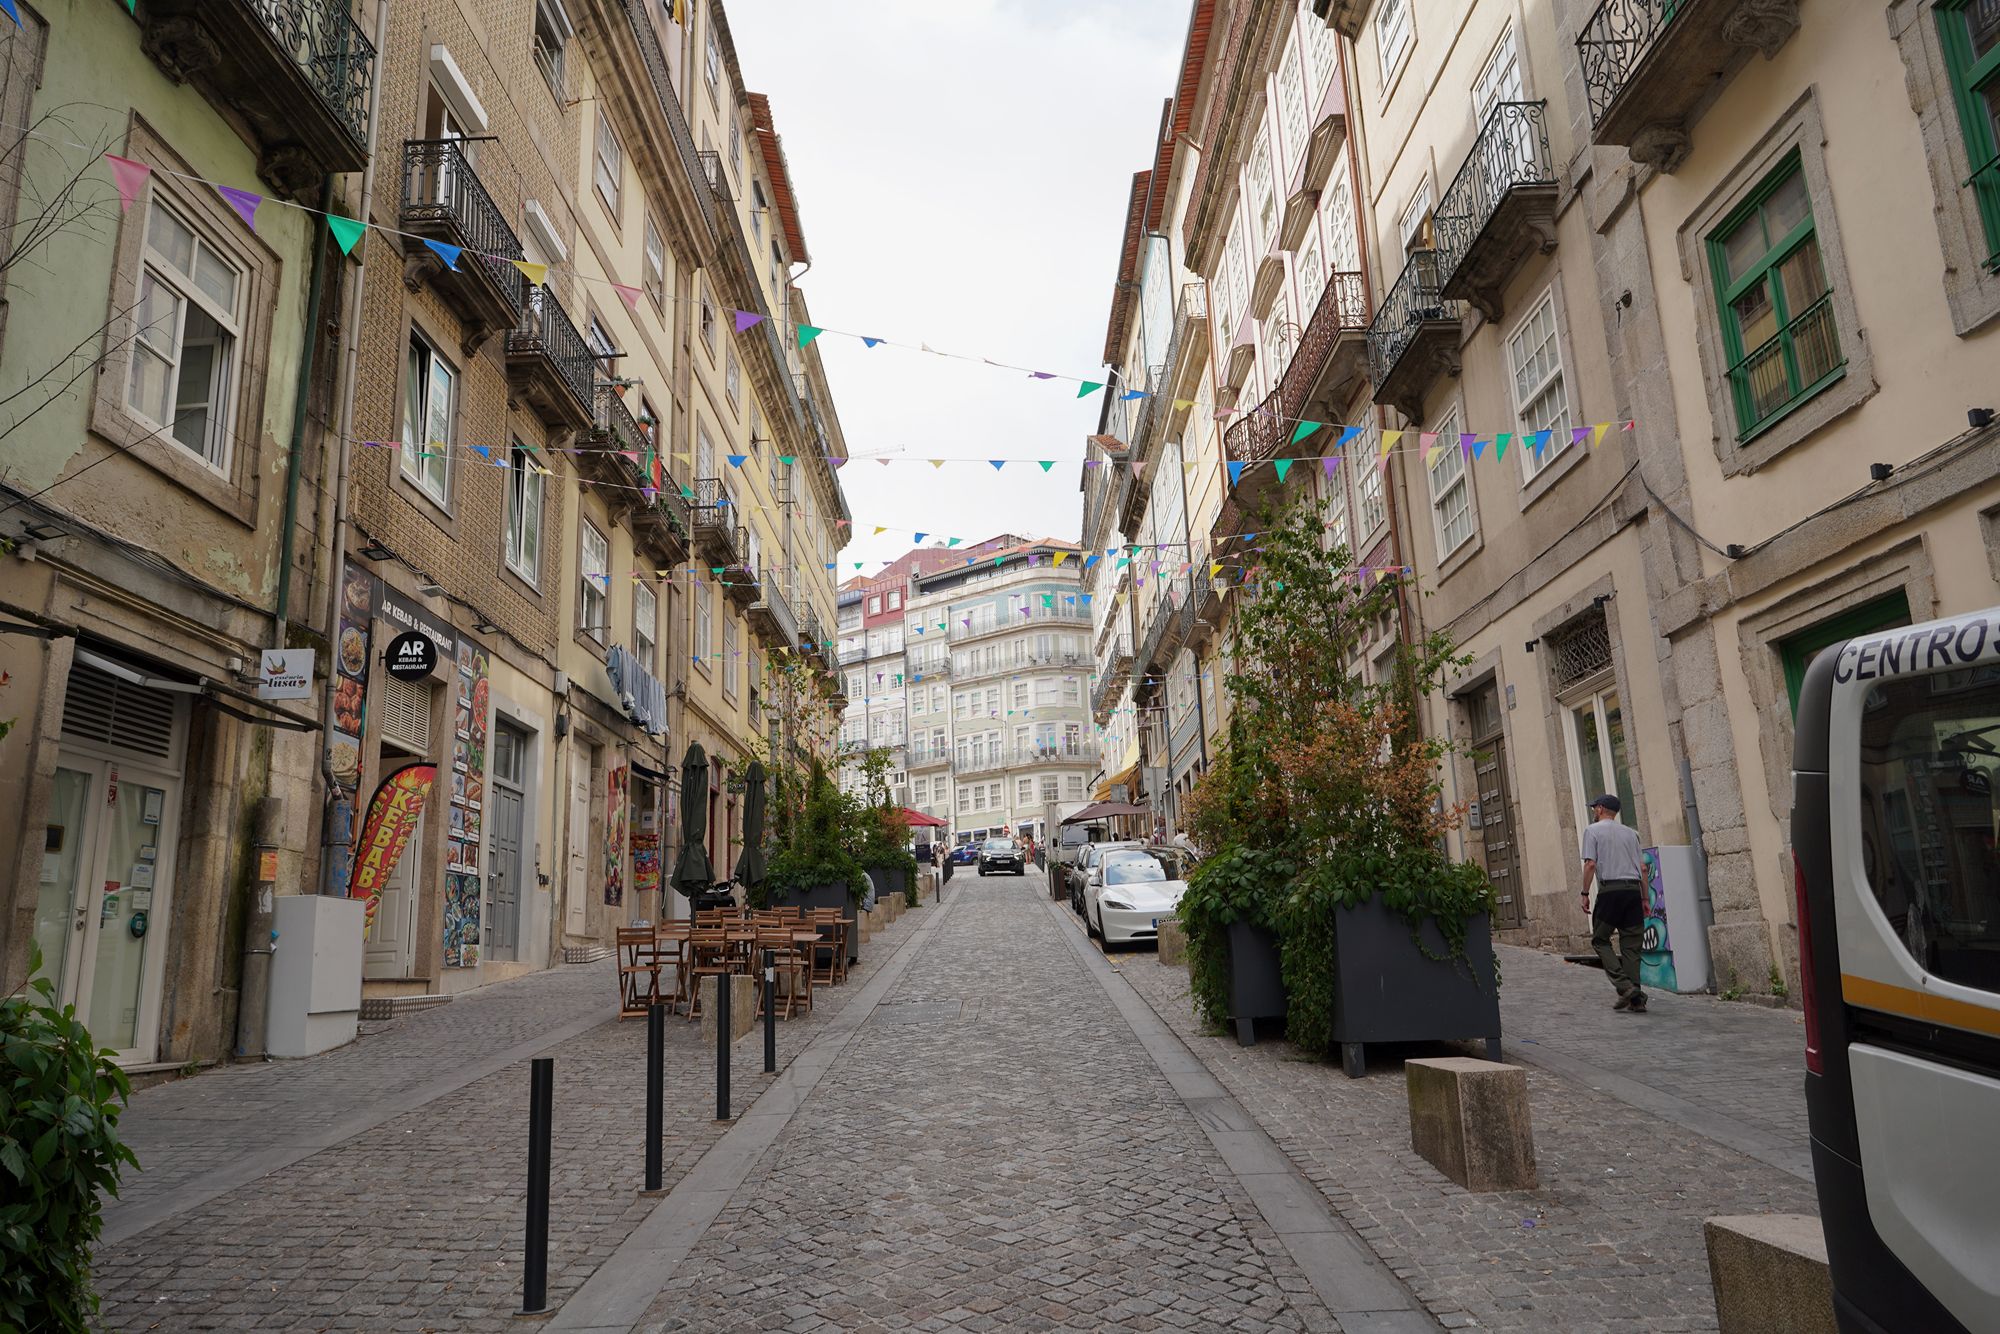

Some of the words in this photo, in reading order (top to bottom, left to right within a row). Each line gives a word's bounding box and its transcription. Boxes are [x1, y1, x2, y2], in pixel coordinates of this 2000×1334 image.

[381, 600, 392, 615] AR
[392, 605, 413, 627] KEBAB
[413, 618, 419, 630] &
[420, 621, 453, 651] RESTAURANT
[398, 640, 425, 656] AR
[1834, 619, 1988, 684] CENTRO
[269, 678, 297, 687] lusa
[356, 788, 413, 888] KEBAB
